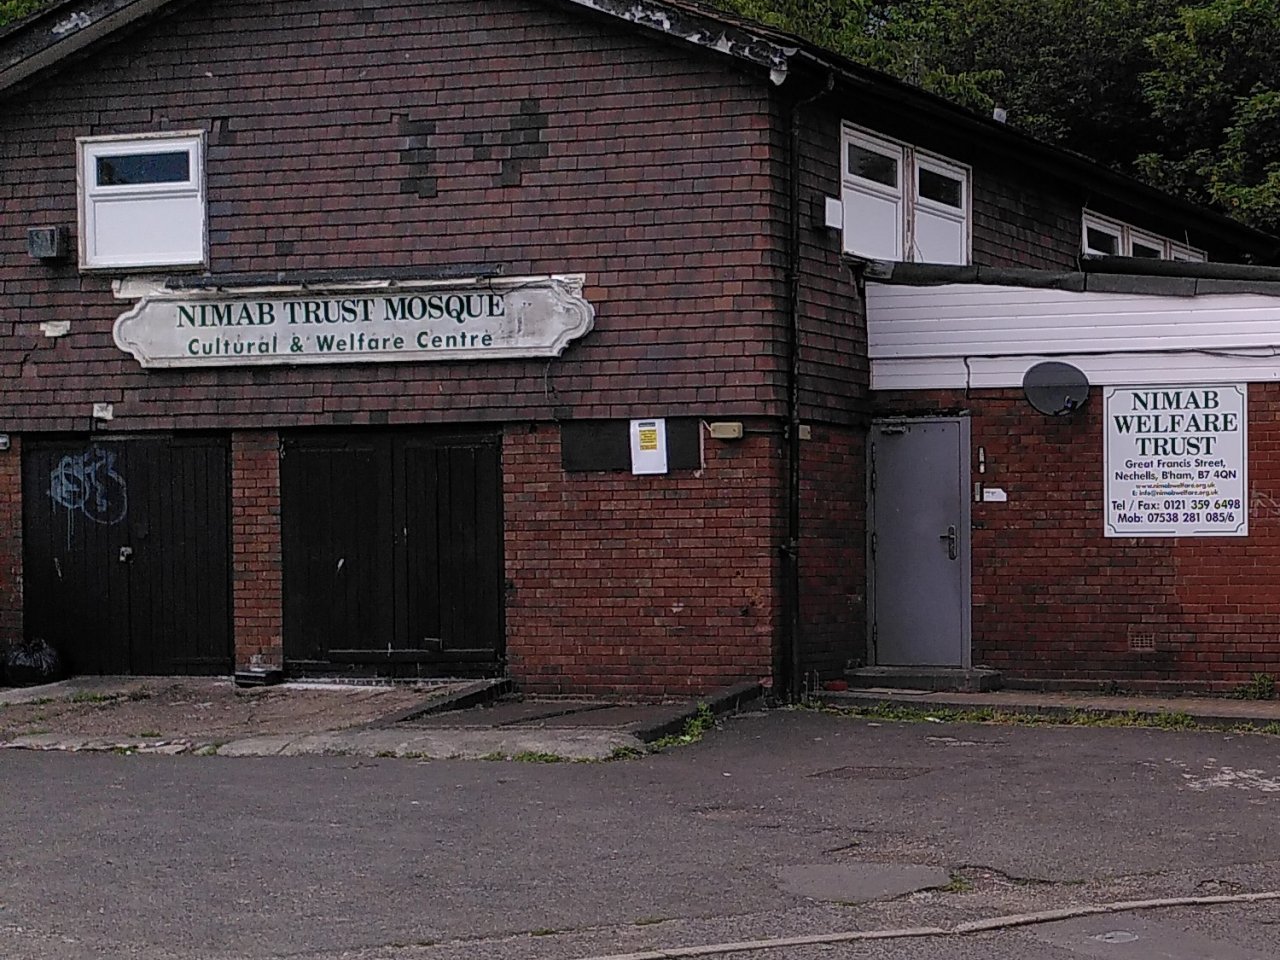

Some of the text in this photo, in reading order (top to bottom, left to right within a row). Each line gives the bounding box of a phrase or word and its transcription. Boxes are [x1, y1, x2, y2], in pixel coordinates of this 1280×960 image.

[177, 294, 506, 328] NIMAB TRUST MOSQUE
[188, 331, 493, 355] Cultural & Welfare Centre
[1131, 390, 1219, 411] NIMAB
[1113, 413, 1238, 434] WELFARE
[1135, 436, 1217, 456] TRUST
[1125, 458, 1226, 469] Great Francis Street,
[1115, 469, 1237, 482] Nechells, B'ham, B7 4QN
[1111, 500, 1126, 511] Tel
[1137, 500, 1161, 511] Fax:
[1163, 499, 1187, 510] 0121
[1190, 499, 1211, 510] 359
[1213, 499, 1241, 510] 6498
[1117, 511, 1235, 524] Mob: 07538 281 085/6
